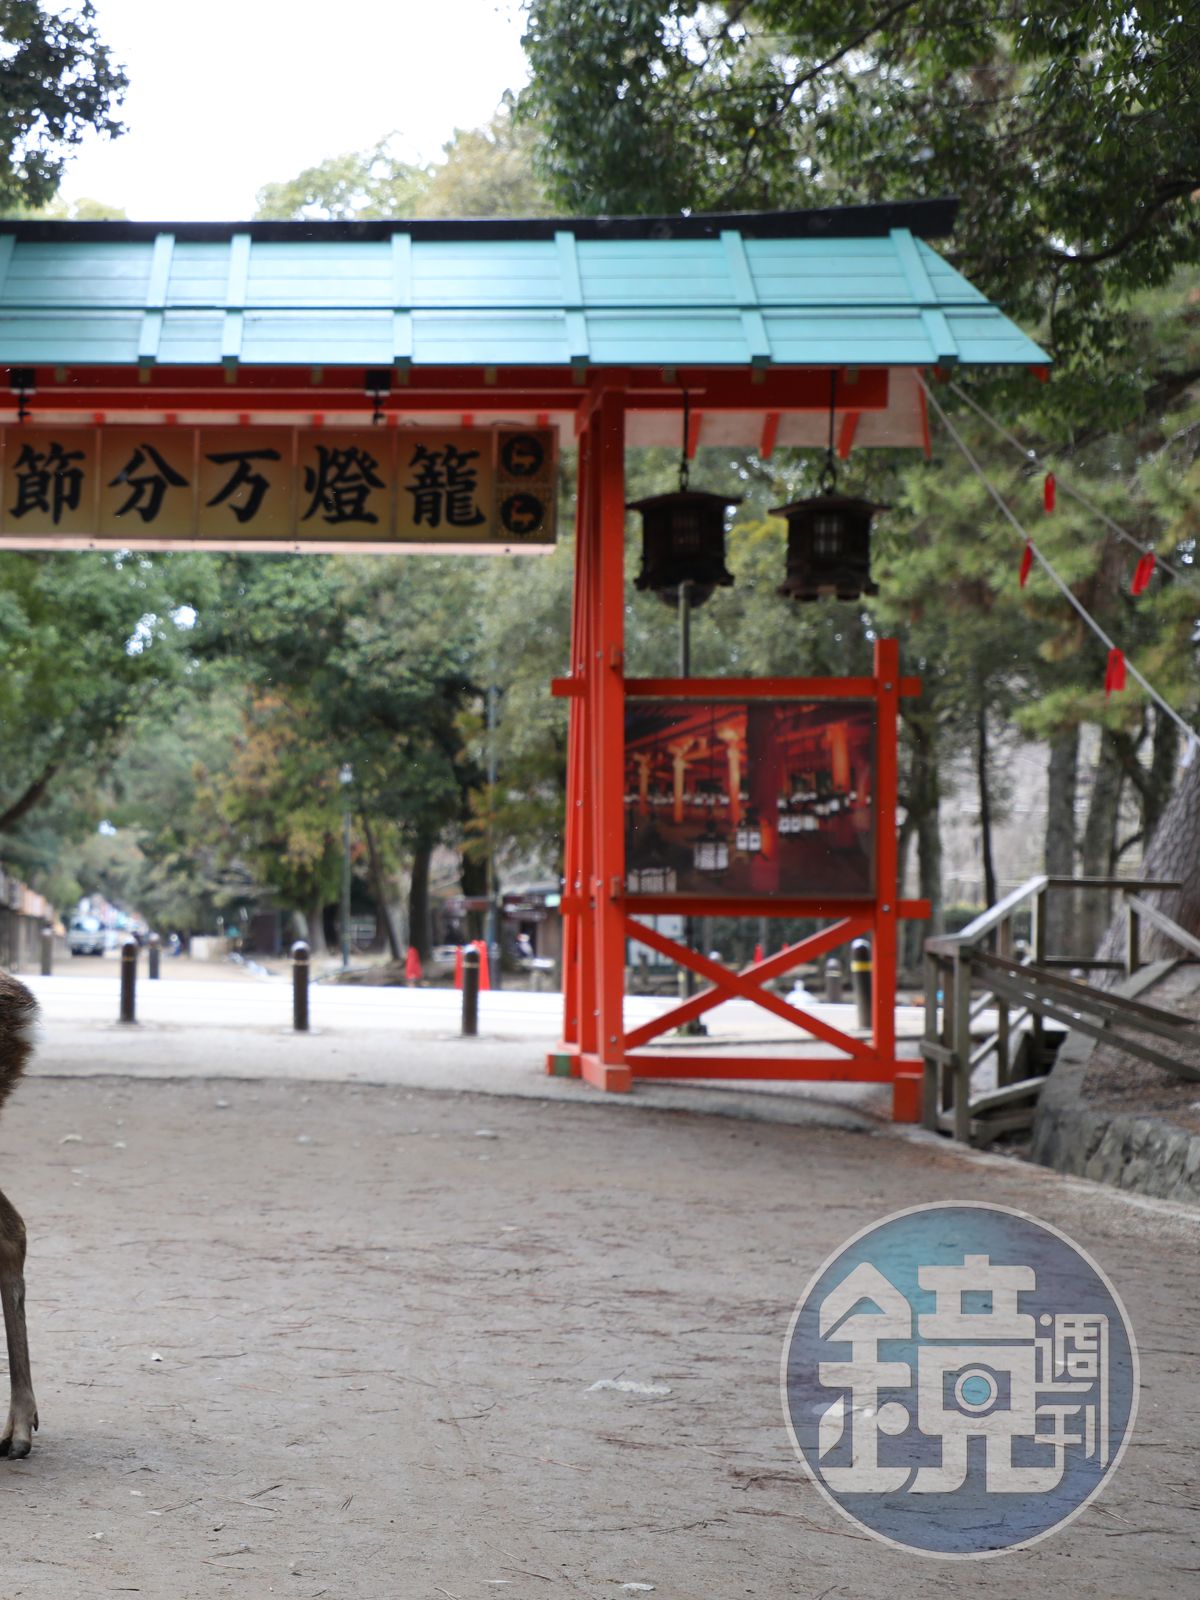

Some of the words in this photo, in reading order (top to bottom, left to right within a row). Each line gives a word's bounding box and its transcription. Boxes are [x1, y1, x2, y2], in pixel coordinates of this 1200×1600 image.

[9, 442, 486, 528] 節分万燈籠
